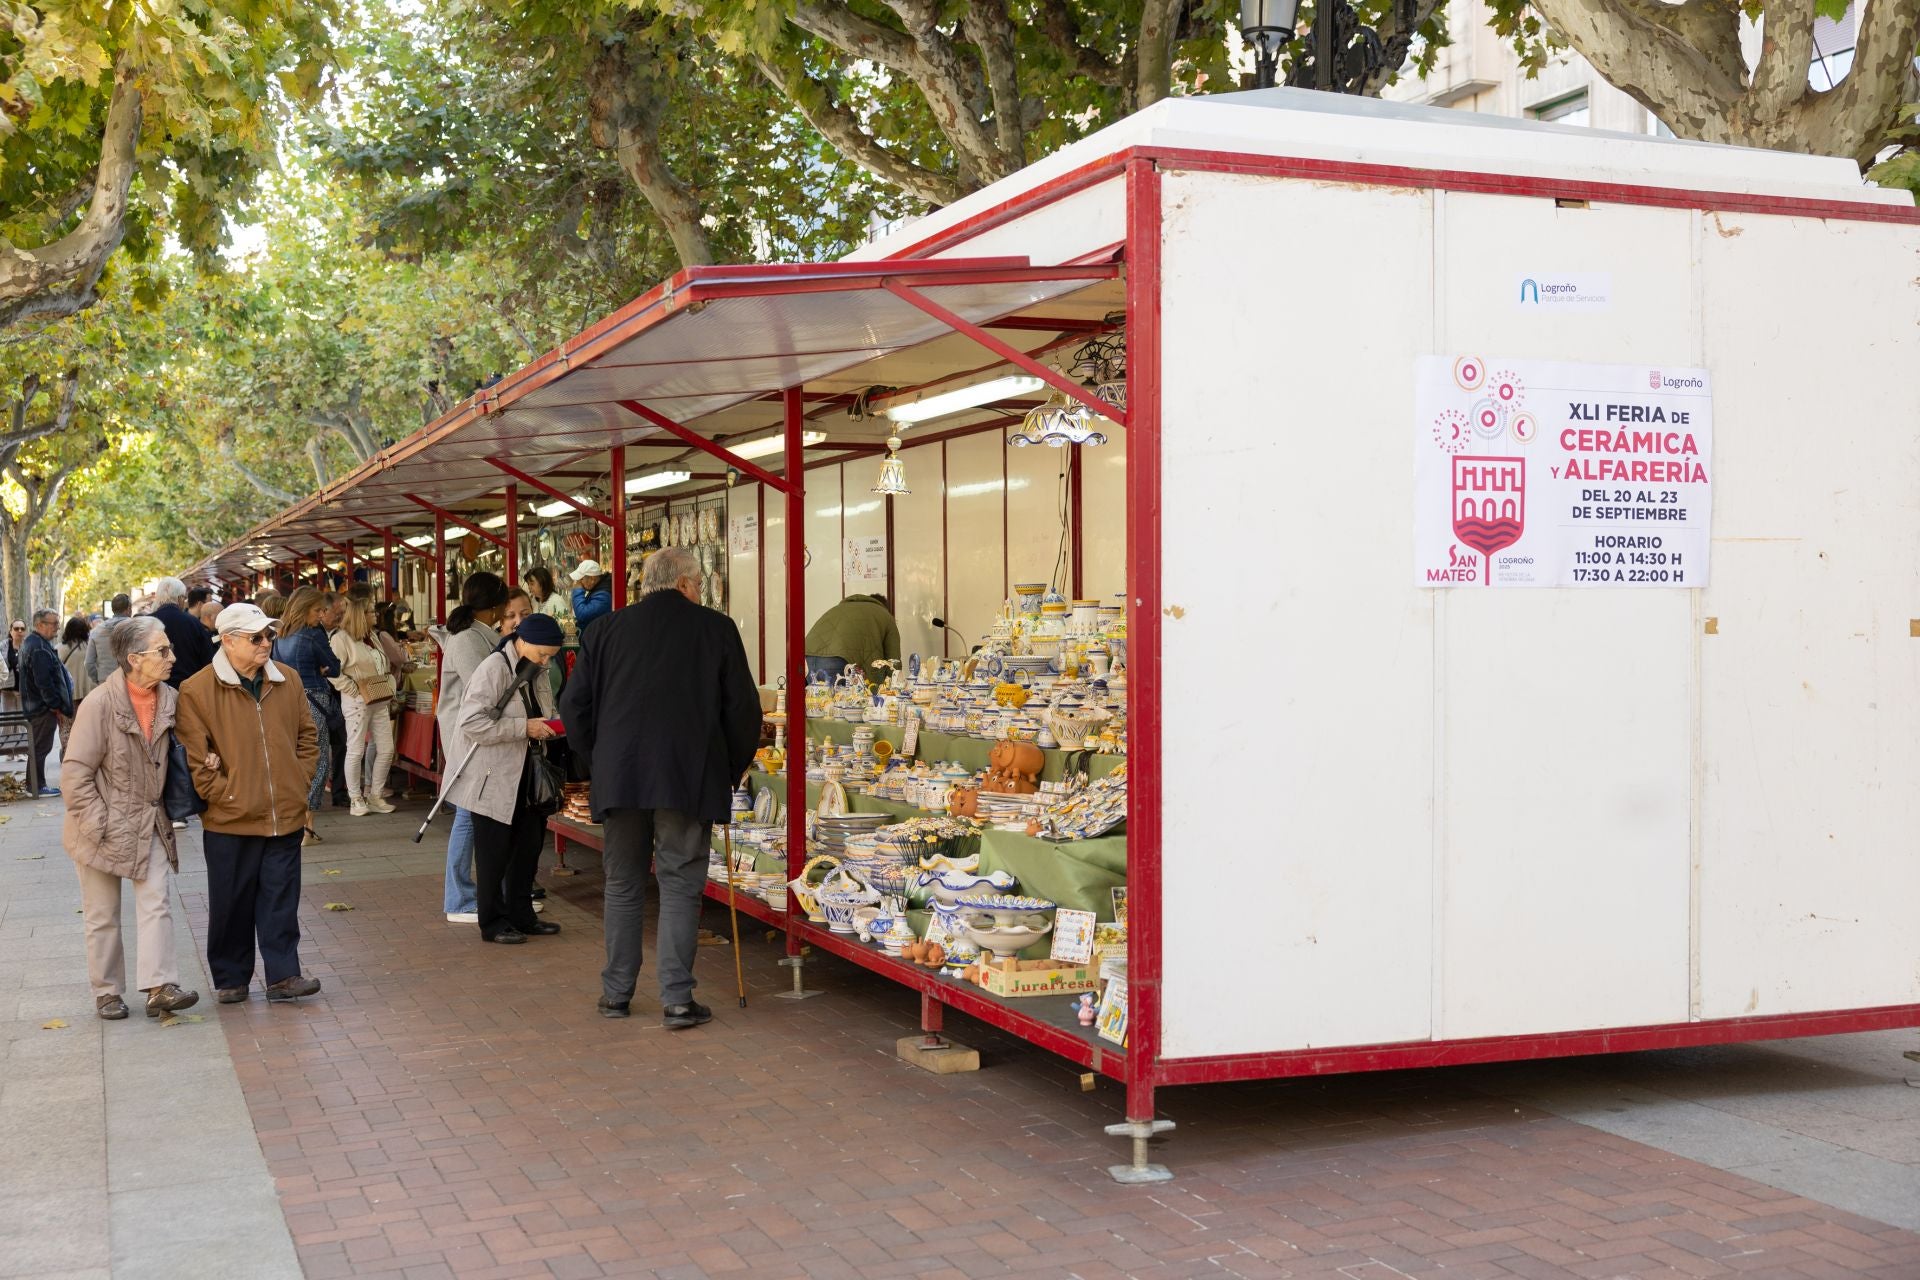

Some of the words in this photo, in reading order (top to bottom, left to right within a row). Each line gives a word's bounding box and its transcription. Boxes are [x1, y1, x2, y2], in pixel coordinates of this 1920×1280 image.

[1541, 283, 1577, 294] Logroño
[1541, 294, 1565, 303] Parque
[1566, 294, 1574, 302] de
[1576, 294, 1606, 302] Servicios
[1663, 376, 1703, 389] Logroño
[1569, 403, 1599, 421] XLI
[1606, 404, 1666, 423] FERIA
[1671, 412, 1689, 424] DE
[1560, 425, 1698, 455] CERÁMICA
[1550, 467, 1560, 479] Y
[1564, 457, 1708, 483] ALFARERÍA
[1582, 489, 1610, 502] DEL
[1614, 490, 1632, 502] 20
[1636, 491, 1655, 503] AL
[1660, 491, 1678, 503] 23
[1572, 506, 1591, 519] DE
[1595, 507, 1687, 521] SEPTIEMBRE
[1595, 535, 1662, 549] HORARIO
[1498, 556, 1534, 564] LOGROÑO
[1575, 552, 1611, 564] 11:00
[1615, 553, 1626, 564] A
[1629, 552, 1667, 565] 14:30
[1671, 553, 1682, 565] H
[1427, 569, 1477, 582] MATEO
[1572, 569, 1610, 582] 17:30
[1614, 569, 1625, 582] A
[1628, 570, 1669, 582] 22:00
[1673, 570, 1684, 582] H
